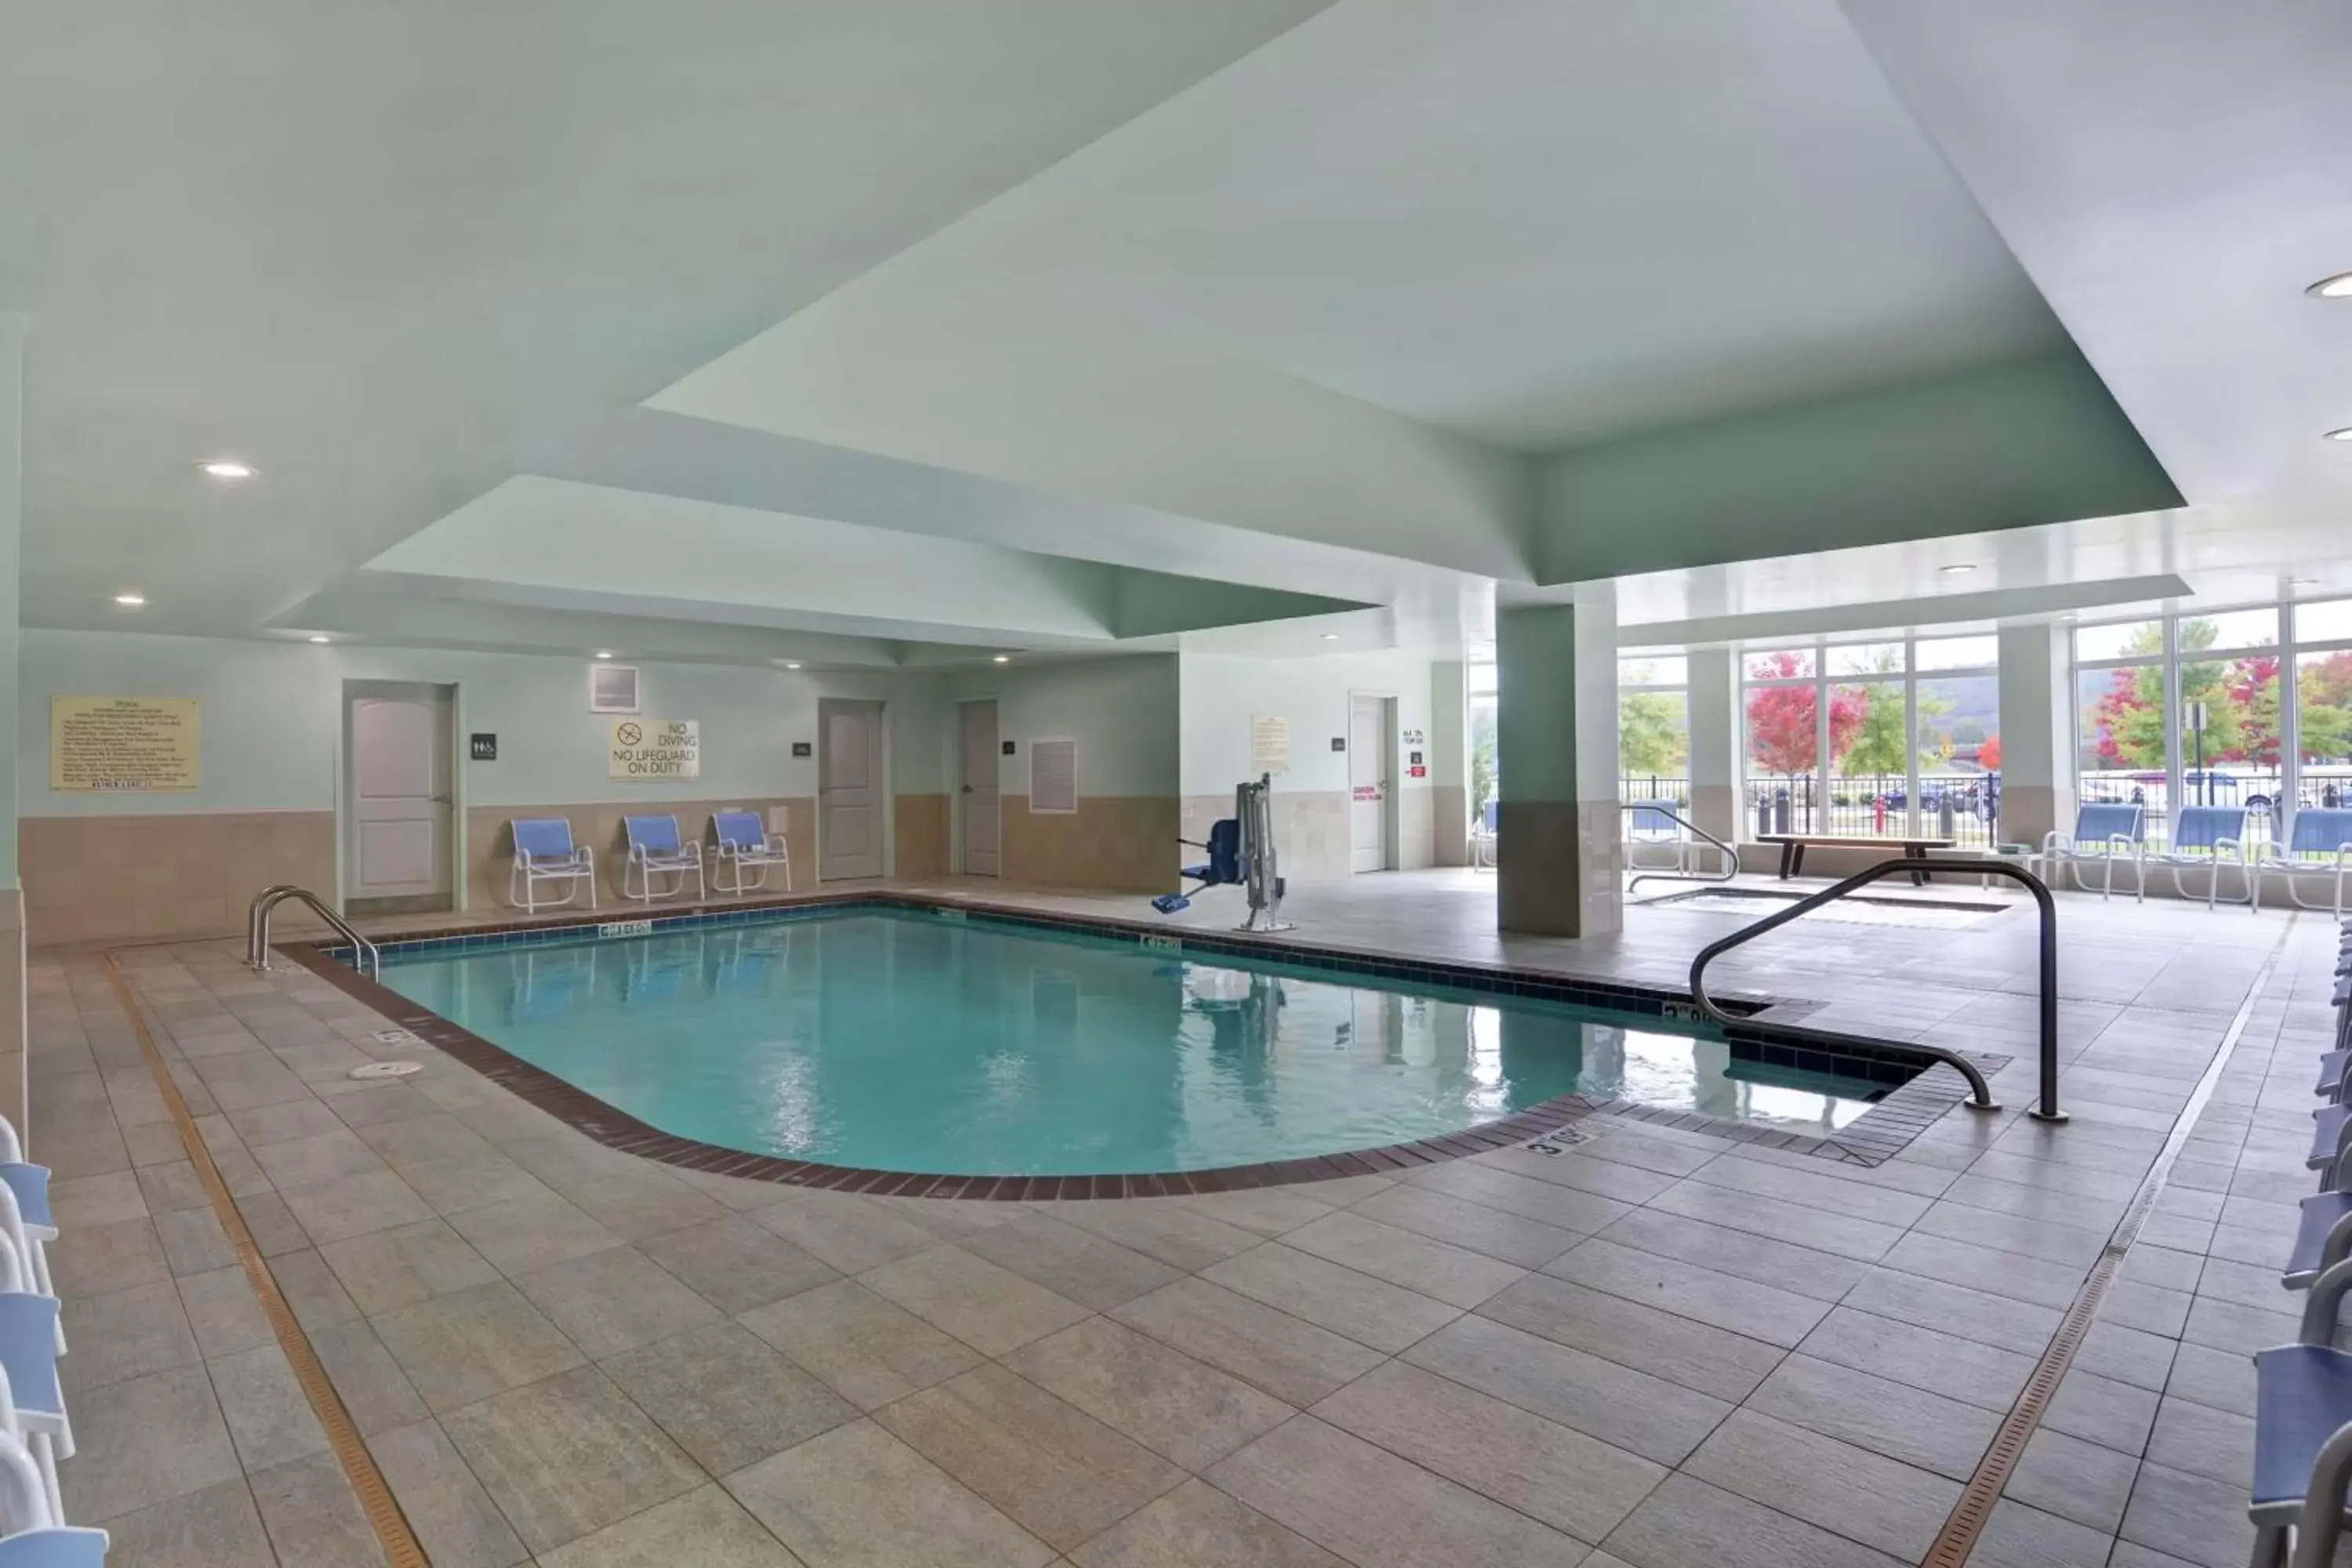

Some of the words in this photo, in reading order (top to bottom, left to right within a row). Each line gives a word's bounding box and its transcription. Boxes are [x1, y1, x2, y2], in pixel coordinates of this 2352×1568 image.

[668, 723, 688, 735] NO
[659, 735, 697, 747] DIVING
[614, 750, 633, 761] NO
[636, 750, 695, 761] LIFEGUARD
[628, 762, 647, 774] ON
[650, 762, 681, 774] DUTY
